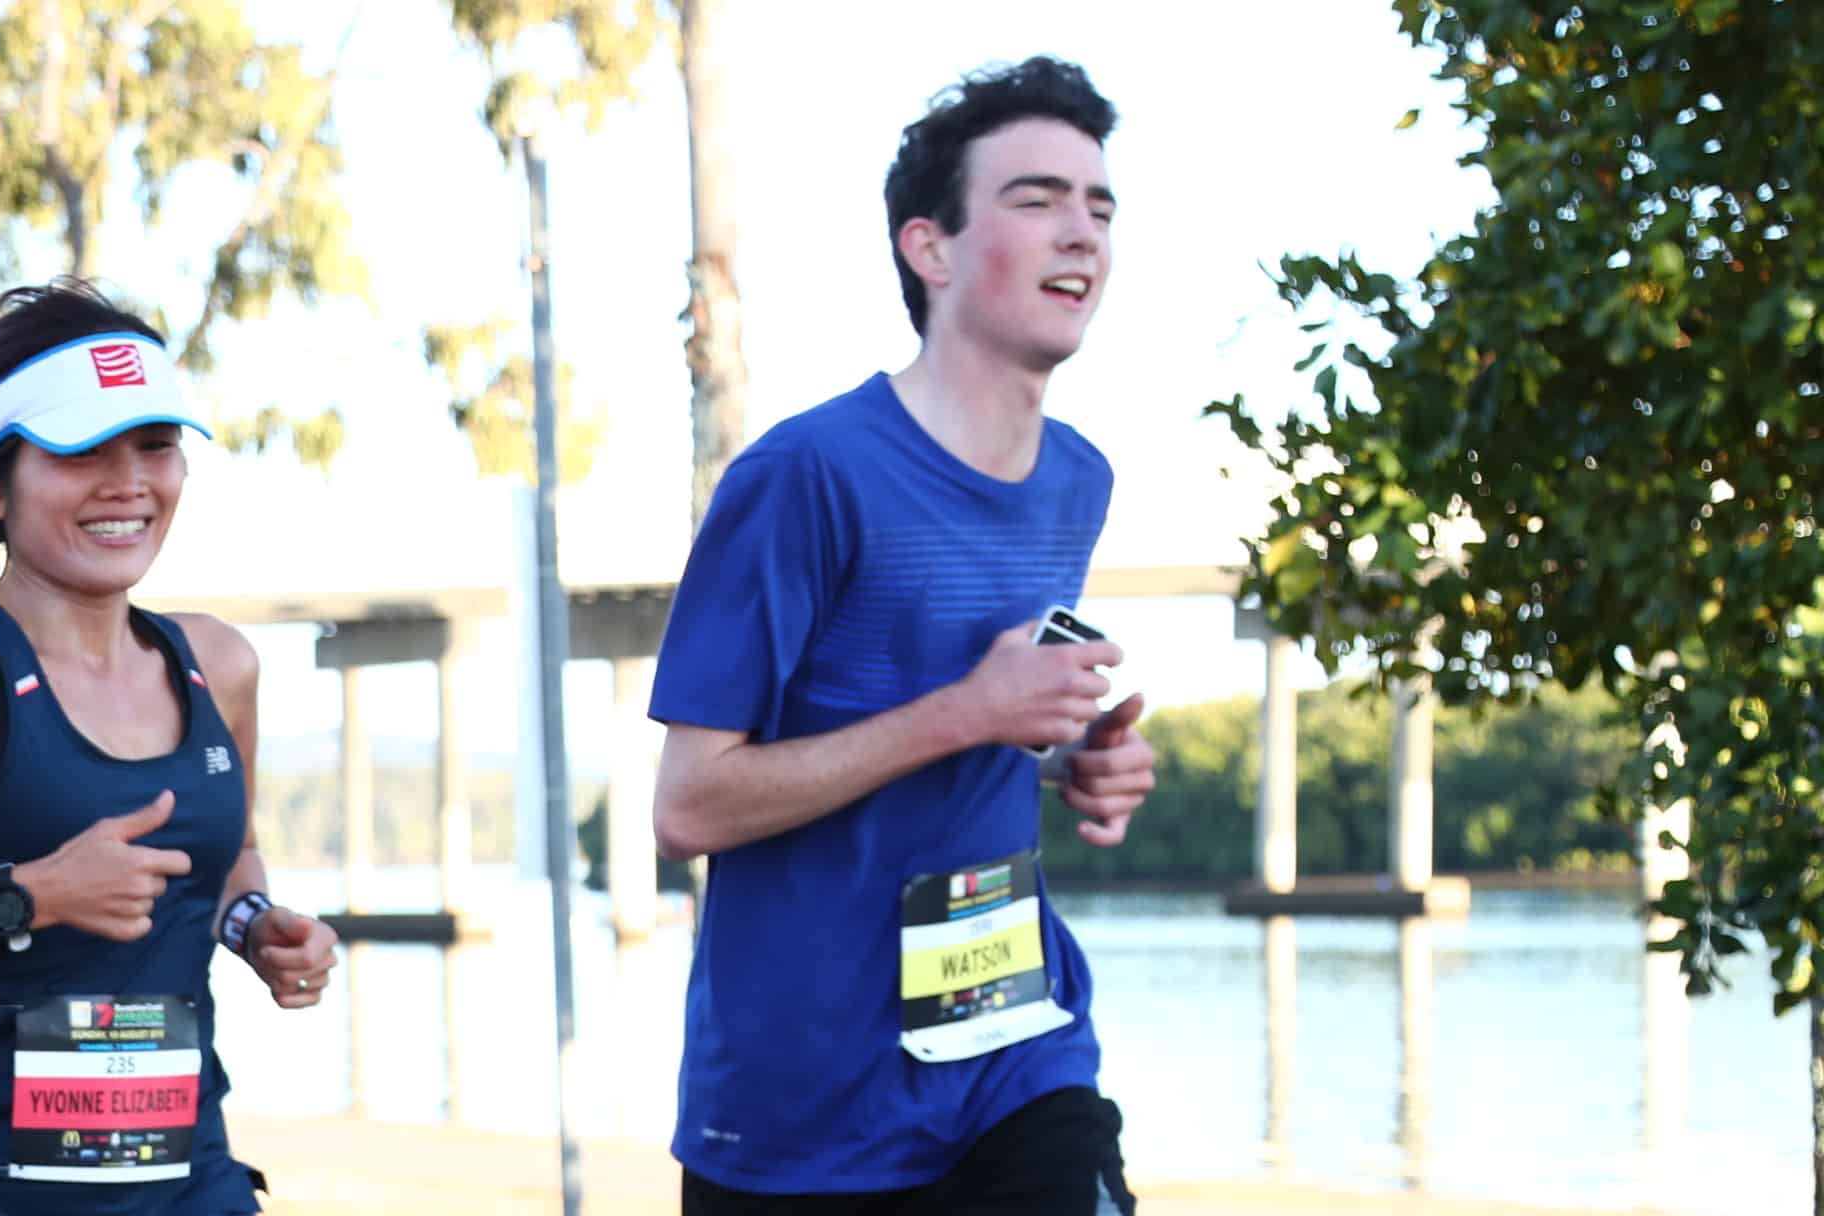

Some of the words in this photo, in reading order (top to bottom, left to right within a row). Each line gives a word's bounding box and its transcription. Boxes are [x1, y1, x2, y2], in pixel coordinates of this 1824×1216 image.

[940, 940, 1012, 980] WATSON
[105, 1056, 137, 1074] 235
[29, 1089, 106, 1114] YVONNE
[110, 1087, 190, 1113] ELIZABETH
